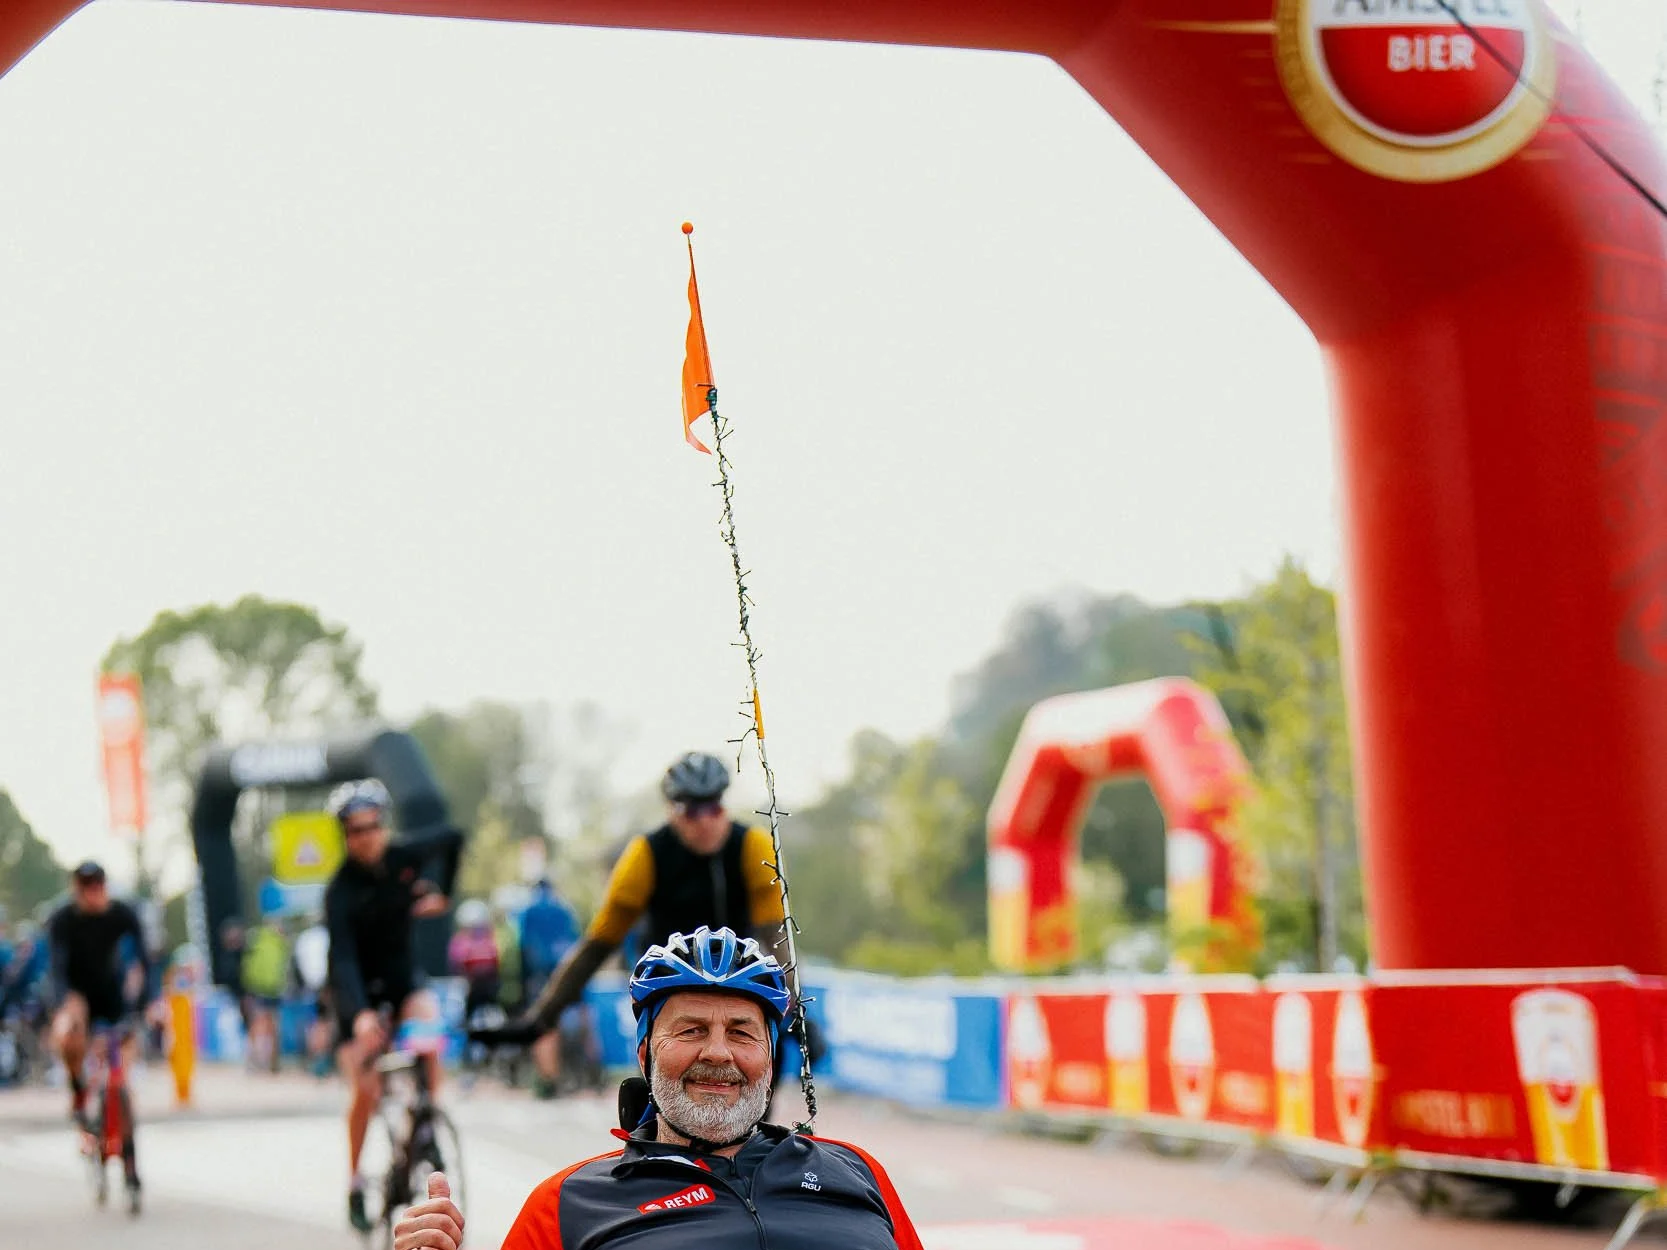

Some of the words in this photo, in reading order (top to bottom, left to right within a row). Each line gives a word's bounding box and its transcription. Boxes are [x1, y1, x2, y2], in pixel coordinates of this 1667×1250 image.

[1388, 34, 1475, 71] BIER
[801, 1181, 822, 1192] AGU
[664, 1187, 709, 1209] REYM
